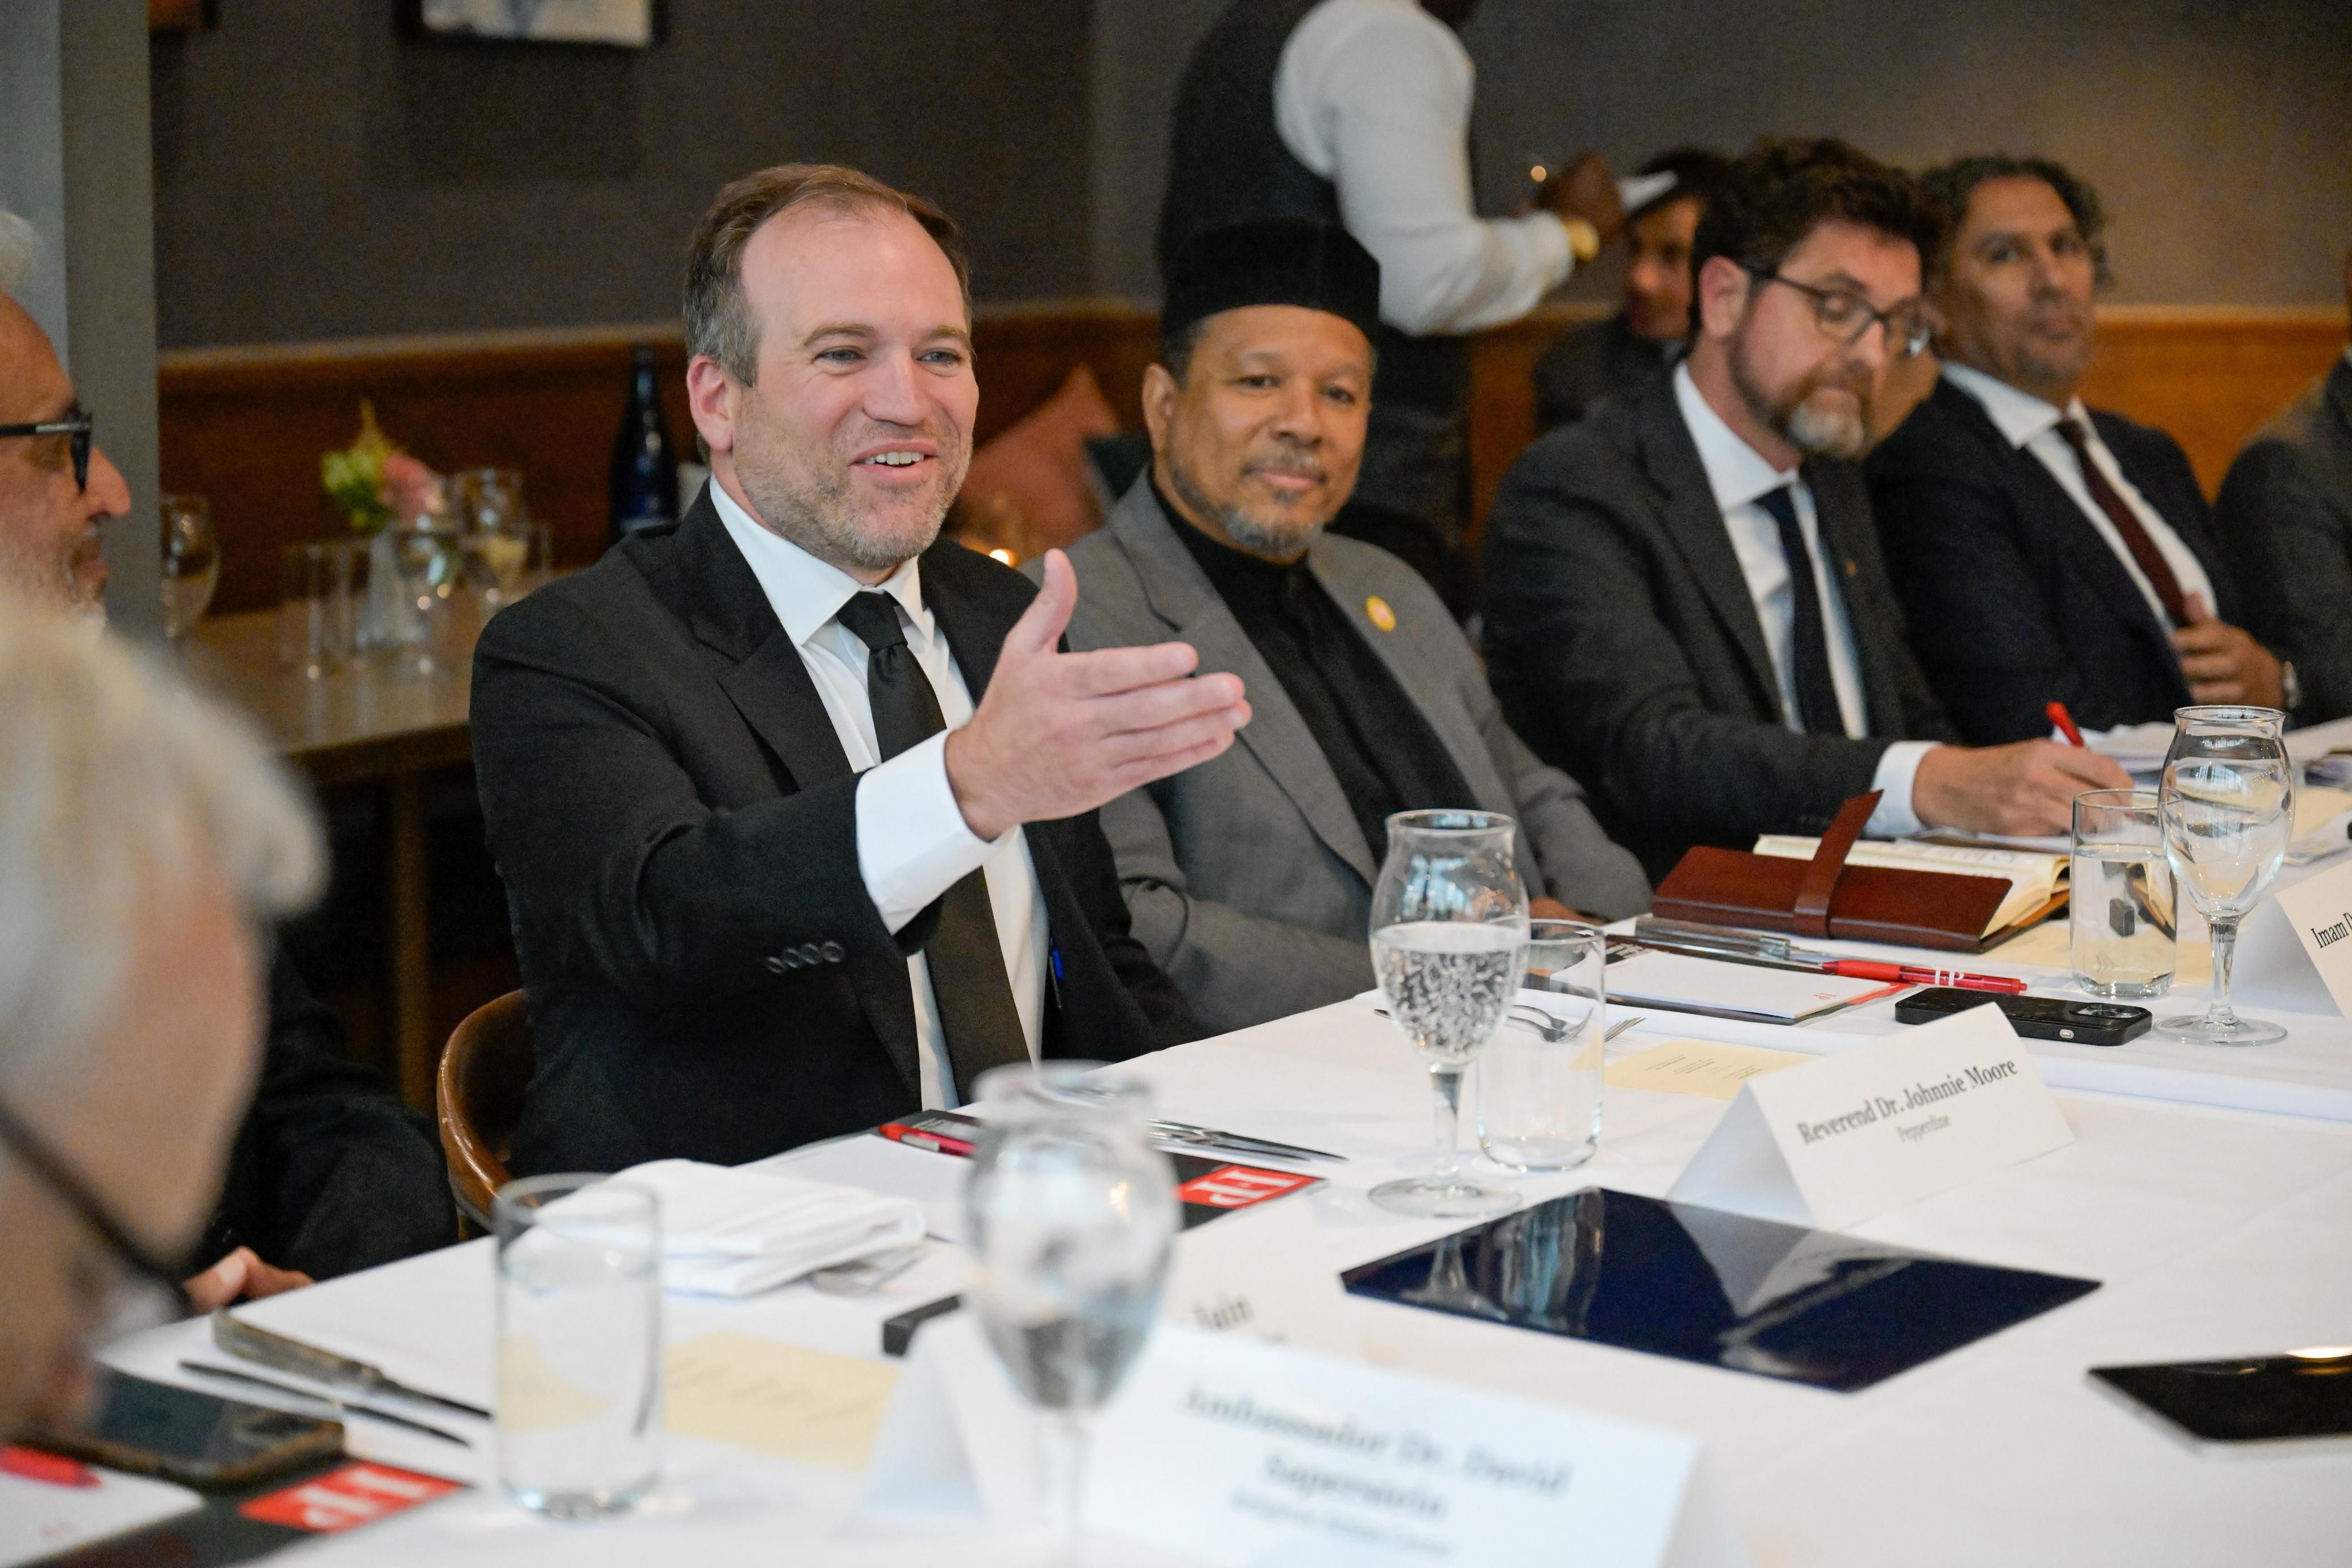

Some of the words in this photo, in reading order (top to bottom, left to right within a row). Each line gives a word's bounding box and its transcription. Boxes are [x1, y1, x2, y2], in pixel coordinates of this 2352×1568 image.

[2310, 928, 2349, 948] Imam
[1797, 1099, 1877, 1144] Reverend
[1875, 1097, 1905, 1119] Dr.
[1904, 1073, 1968, 1110] Johnnie
[1964, 1060, 2019, 1089] Moore
[1462, 1445, 1572, 1498] David
